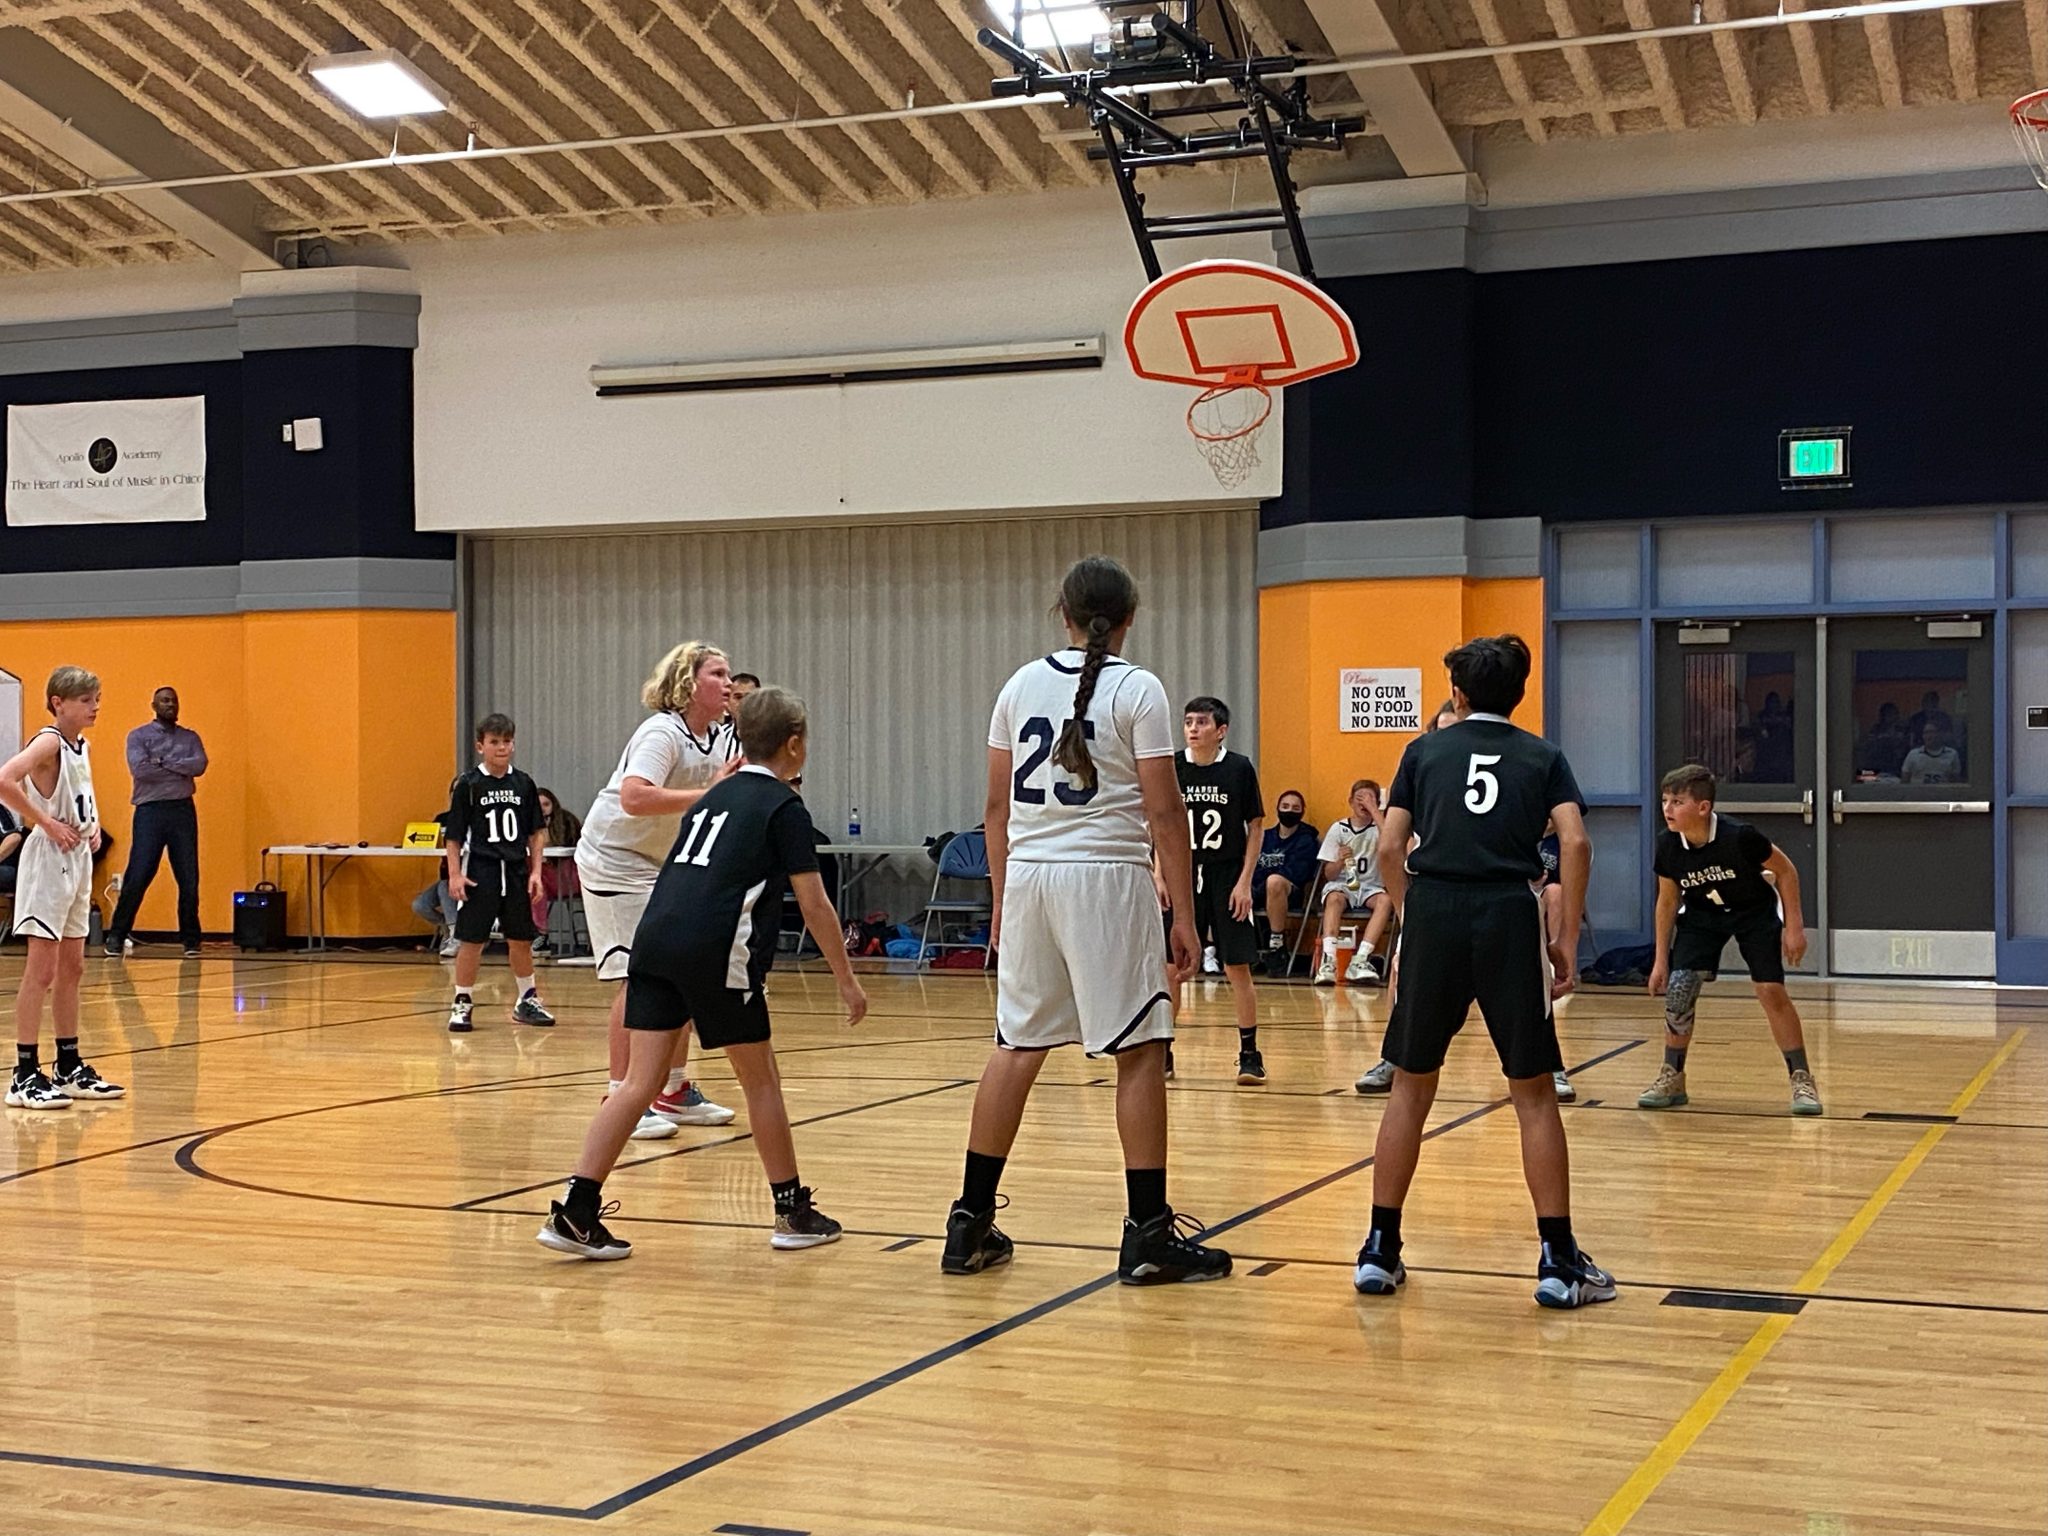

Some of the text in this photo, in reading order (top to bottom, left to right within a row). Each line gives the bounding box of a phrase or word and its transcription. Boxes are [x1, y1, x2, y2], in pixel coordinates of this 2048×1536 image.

[57, 451, 162, 464] Apollo Academy
[11, 480, 30, 491] The
[34, 479, 59, 490] Heart
[63, 478, 83, 489] and
[86, 477, 109, 489] Soul
[113, 476, 124, 487] of
[127, 475, 156, 487] Music
[160, 475, 170, 486] in
[1351, 686, 1406, 699] NO GUM
[1351, 701, 1413, 713] NO FOOD
[1351, 716, 1419, 728] NO DRINK
[1014, 716, 1099, 806] 25
[1464, 753, 1502, 815] 5
[480, 796, 521, 806] GATORS
[485, 808, 518, 842] 10
[1187, 809, 1223, 849] 12
[673, 808, 729, 867] 11
[1891, 937, 1935, 968] EXIT
